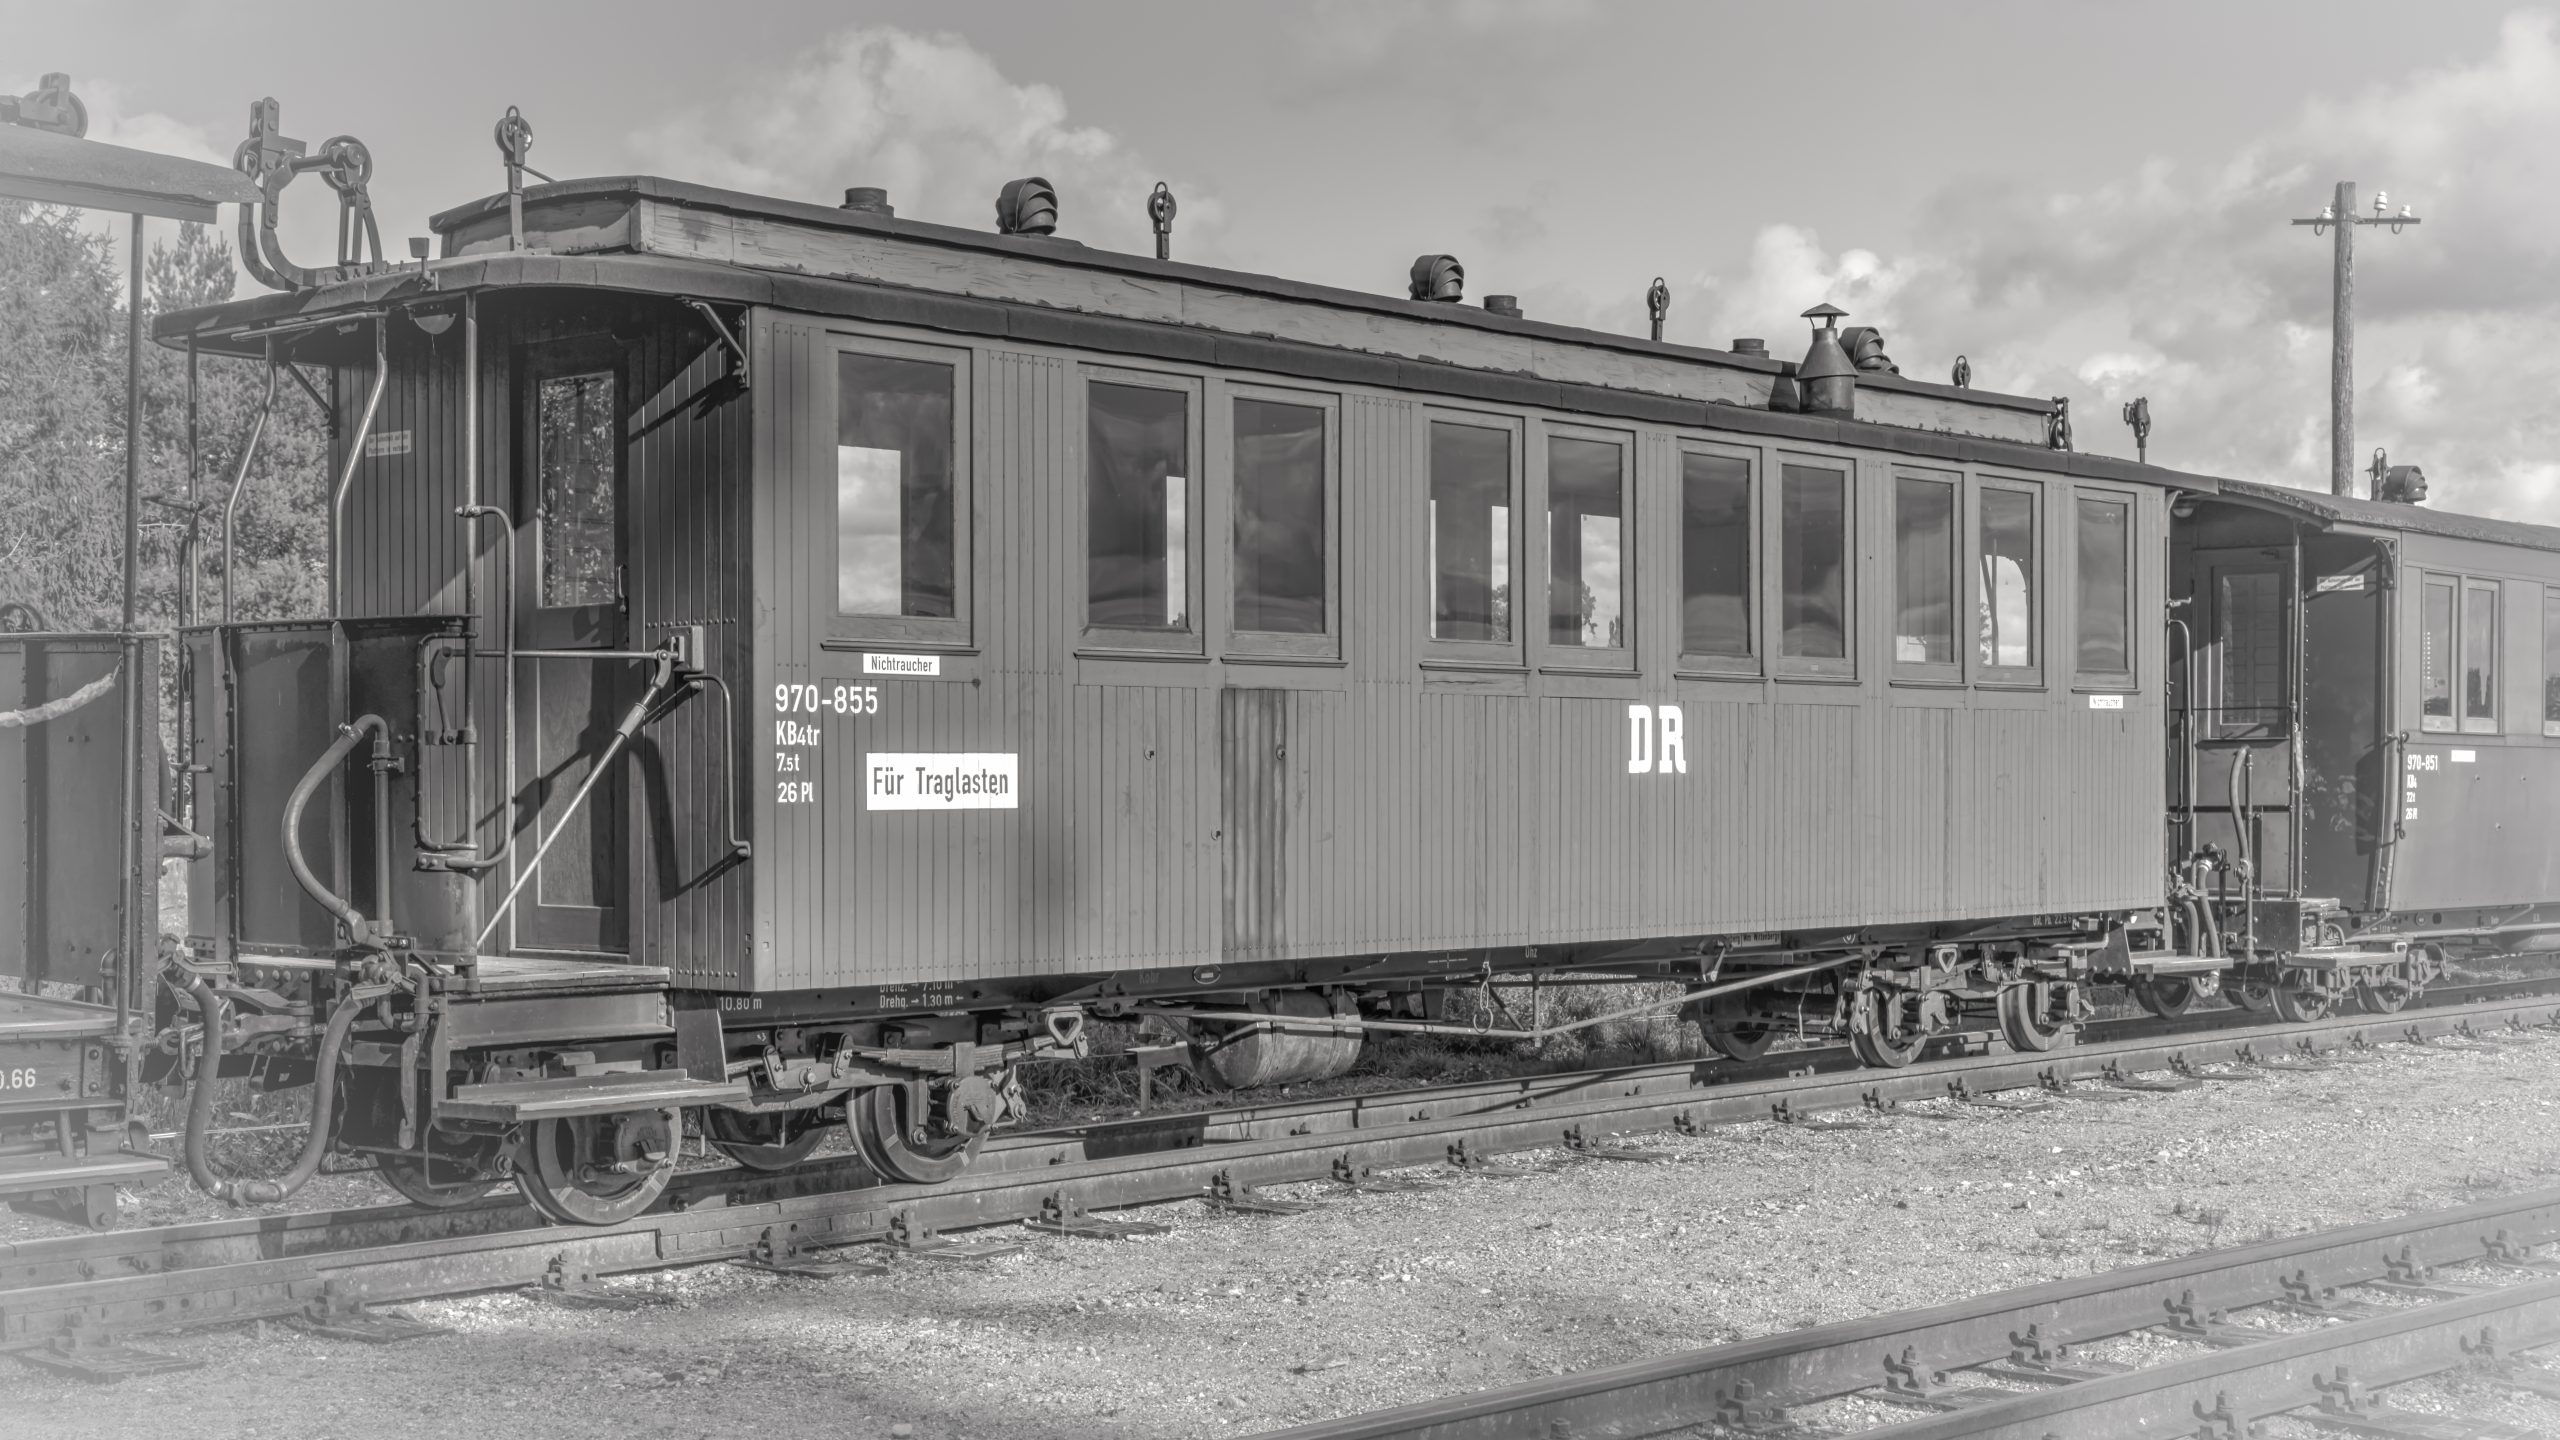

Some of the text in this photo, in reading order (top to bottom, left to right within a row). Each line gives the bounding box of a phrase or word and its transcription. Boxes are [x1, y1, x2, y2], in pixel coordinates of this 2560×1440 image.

[871, 655, 933, 673] Nichtraucher
[775, 684, 878, 714] 970-855
[776, 720, 820, 746] KB4tr
[1628, 704, 1706, 774] DR
[2407, 755, 2438, 771] 970-851
[777, 782, 814, 803] 26 Pl
[872, 766, 1009, 803] Für Traglasten
[720, 997, 762, 1011] 10.80 m
[922, 993, 942, 1008] 1.30
[944, 995, 953, 1006] m
